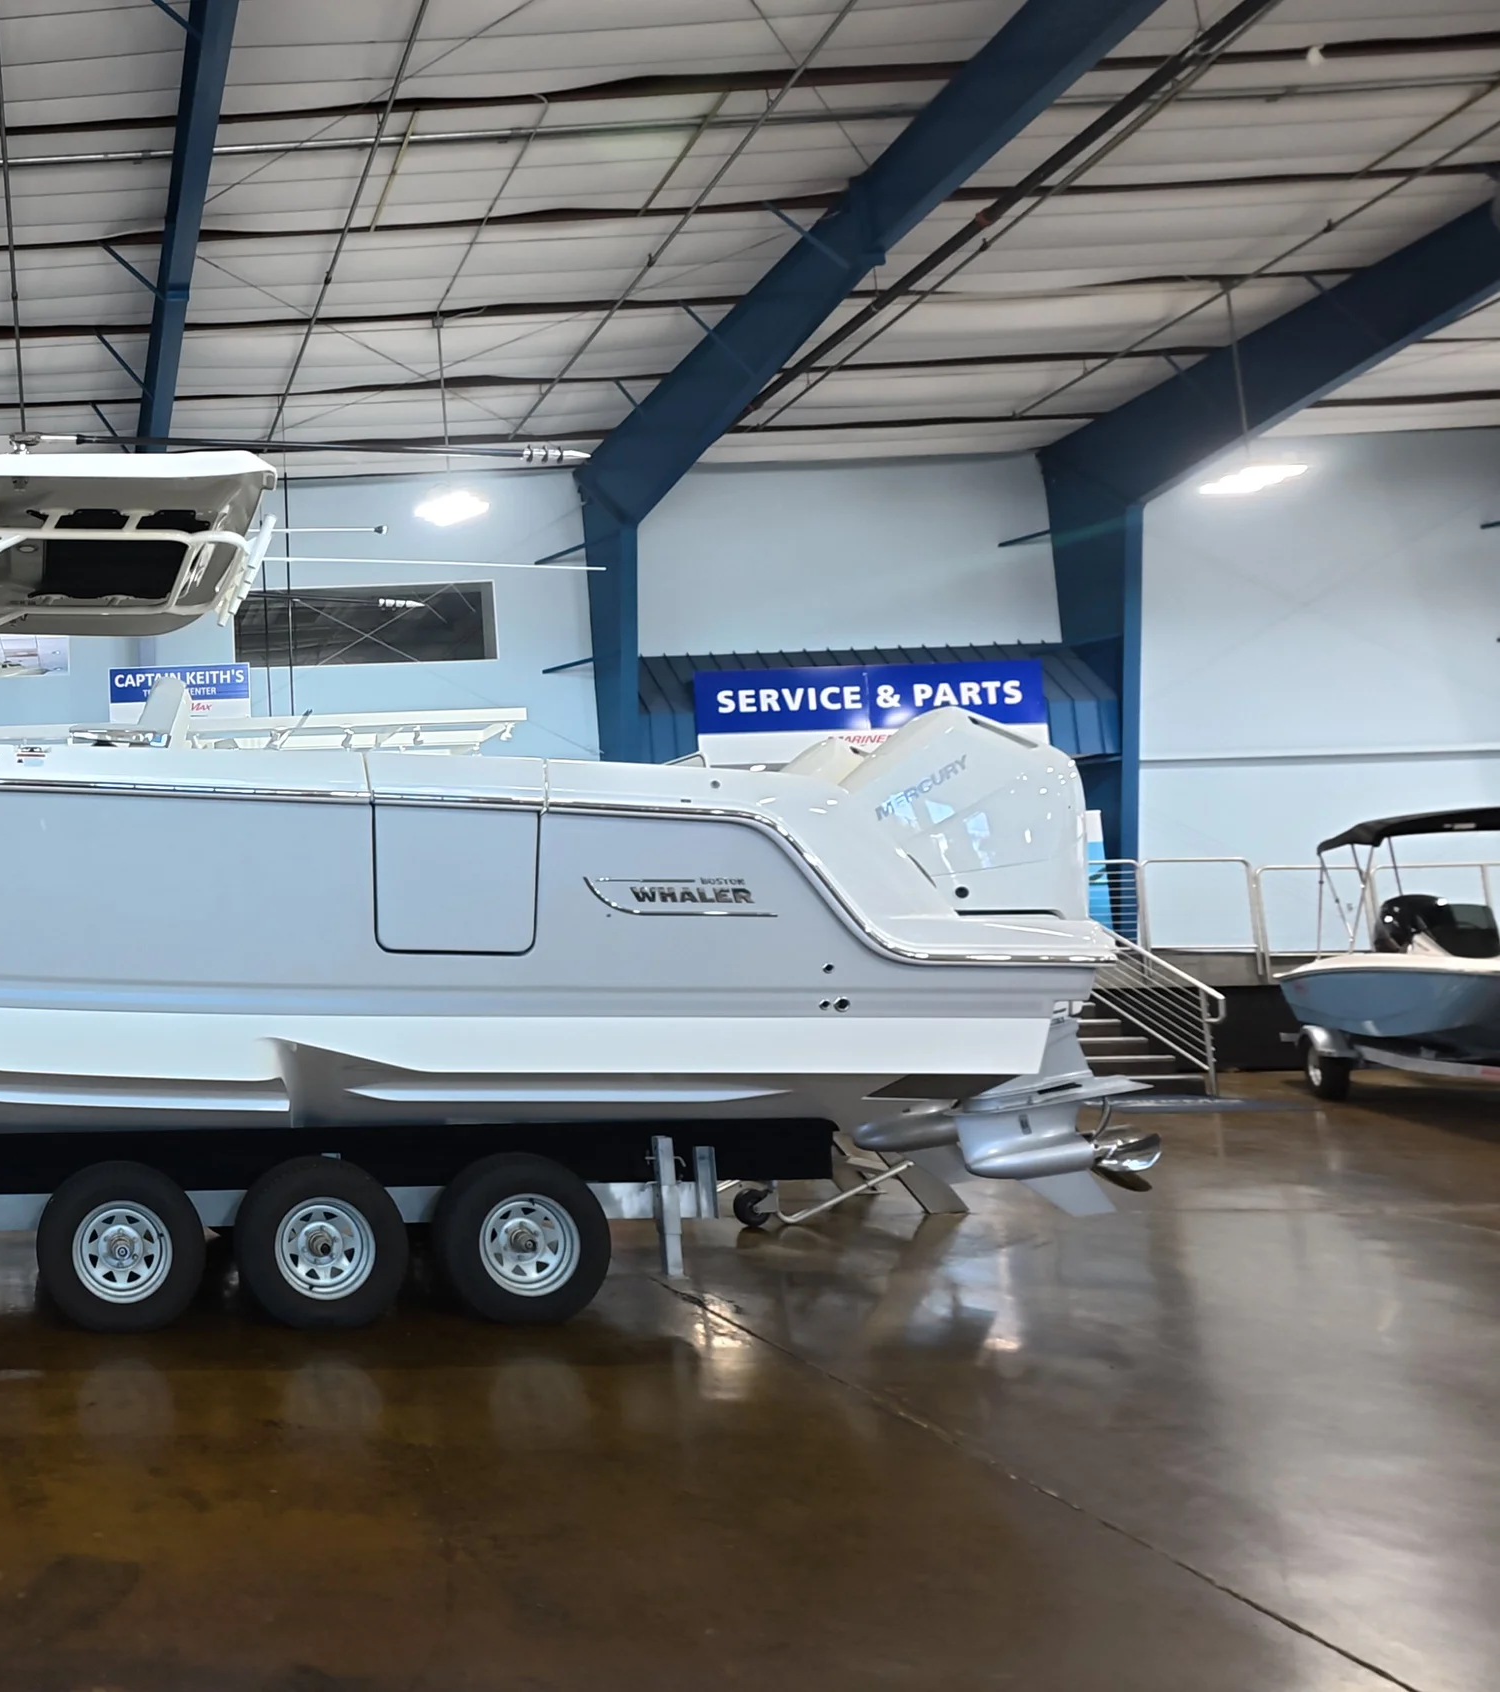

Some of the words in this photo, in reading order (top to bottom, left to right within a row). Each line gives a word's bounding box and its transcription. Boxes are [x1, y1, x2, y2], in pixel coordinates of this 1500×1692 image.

[186, 669, 244, 684] KEITH'S
[716, 686, 863, 714] SERVICE
[875, 684, 901, 708] &
[913, 680, 1023, 707] PARTS
[875, 754, 967, 821] MERCURY
[630, 886, 755, 903] WHALER
